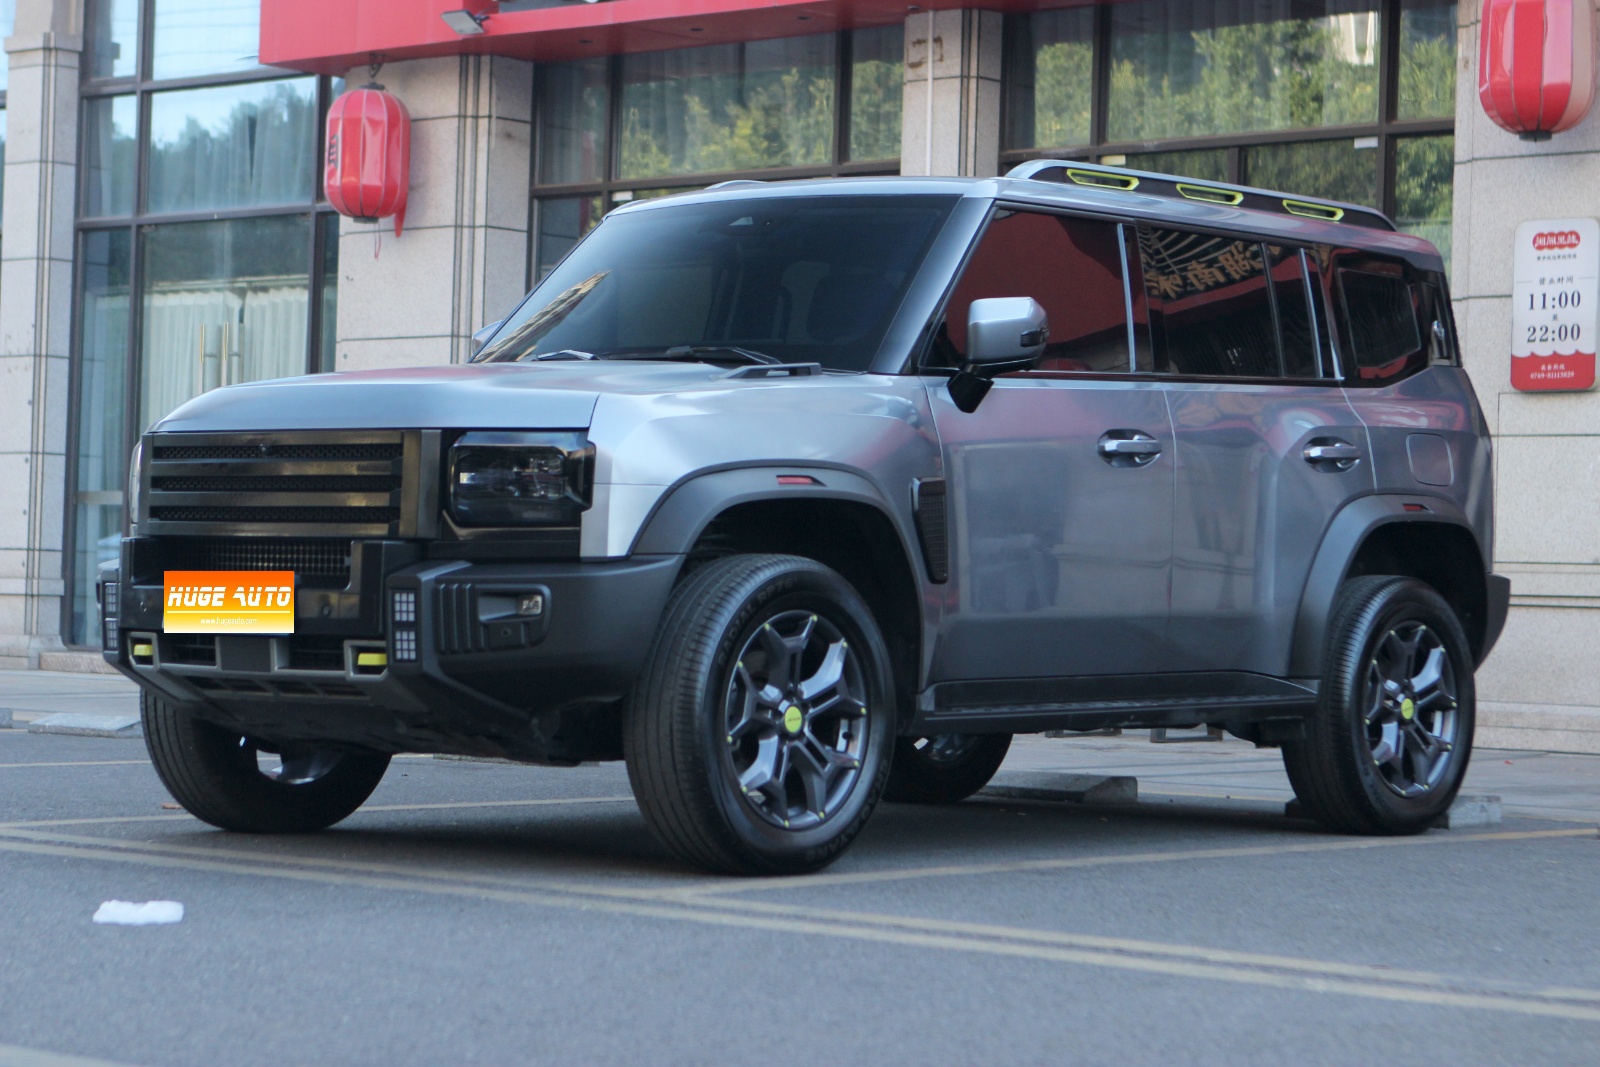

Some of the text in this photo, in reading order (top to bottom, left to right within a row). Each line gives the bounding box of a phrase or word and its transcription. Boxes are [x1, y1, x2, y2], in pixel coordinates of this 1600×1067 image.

[1529, 290, 1581, 310] 11:00
[1527, 323, 1581, 343] 22:00
[717, 602, 758, 666] RADIAL
